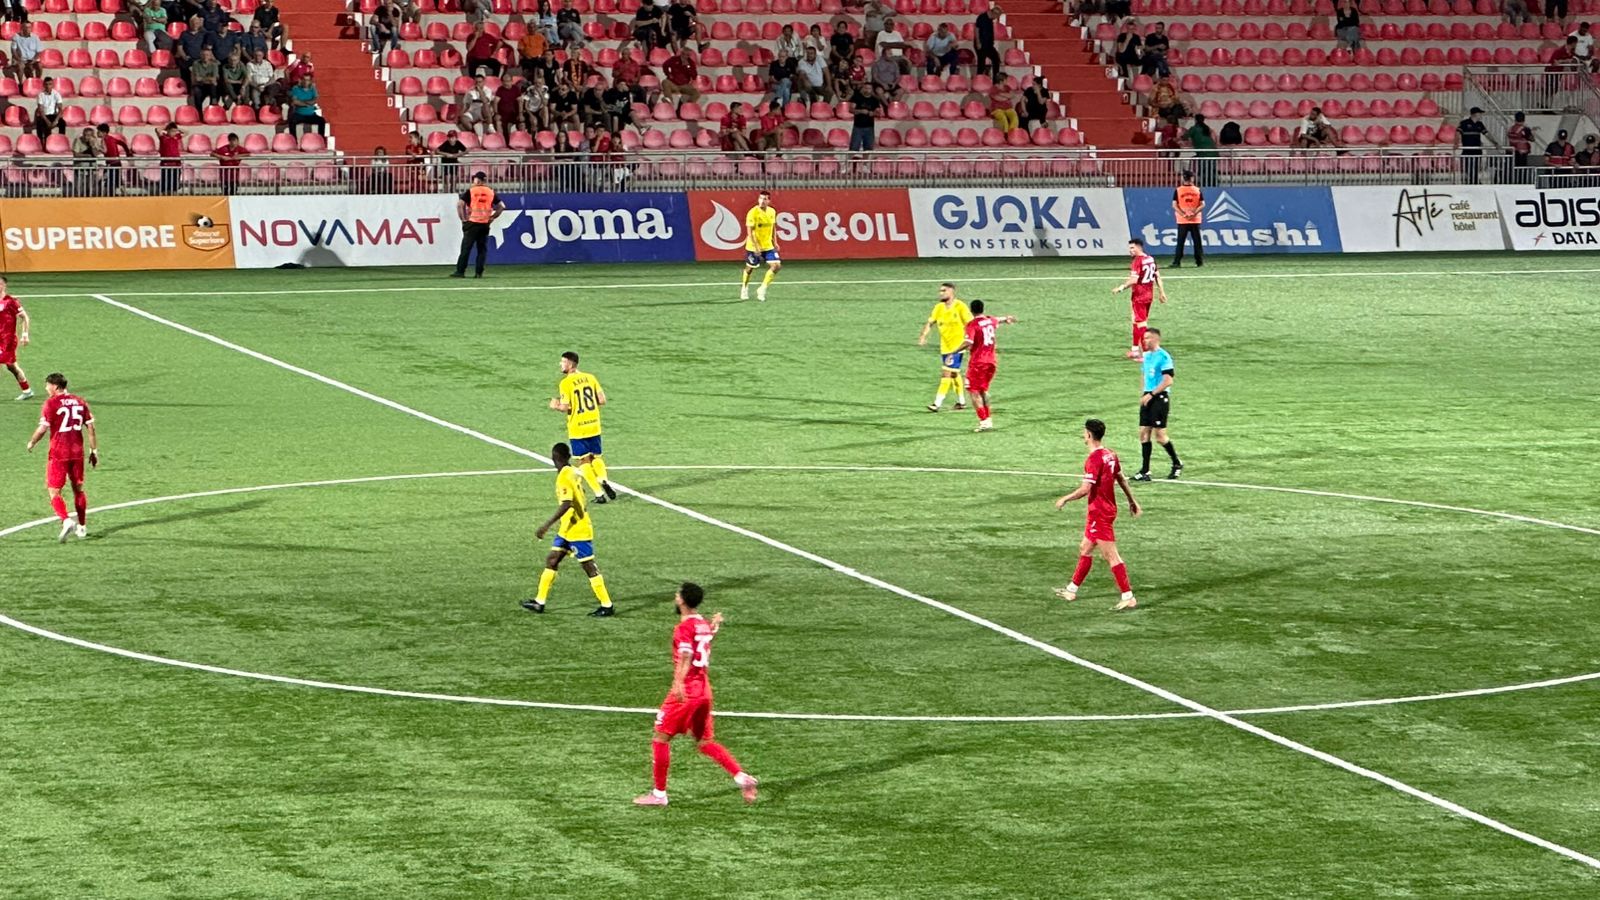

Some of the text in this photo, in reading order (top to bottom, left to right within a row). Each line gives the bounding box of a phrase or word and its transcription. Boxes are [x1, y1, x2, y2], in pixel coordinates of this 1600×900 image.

[933, 194, 1101, 233] GJOKA
[1449, 200, 1470, 211] café
[1451, 211, 1498, 220] restaurant
[1515, 192, 1600, 228] abis
[4, 225, 176, 251] SUPERIORE
[239, 218, 441, 247] NOVAMAT
[775, 212, 910, 242] SP&OIL
[1453, 221, 1476, 231] hôtel
[1552, 232, 1598, 245] DATA
[938, 238, 1104, 250] KONSTRUKSION
[1141, 263, 1155, 284] 28
[574, 386, 595, 414] 18
[56, 405, 84, 433] 25
